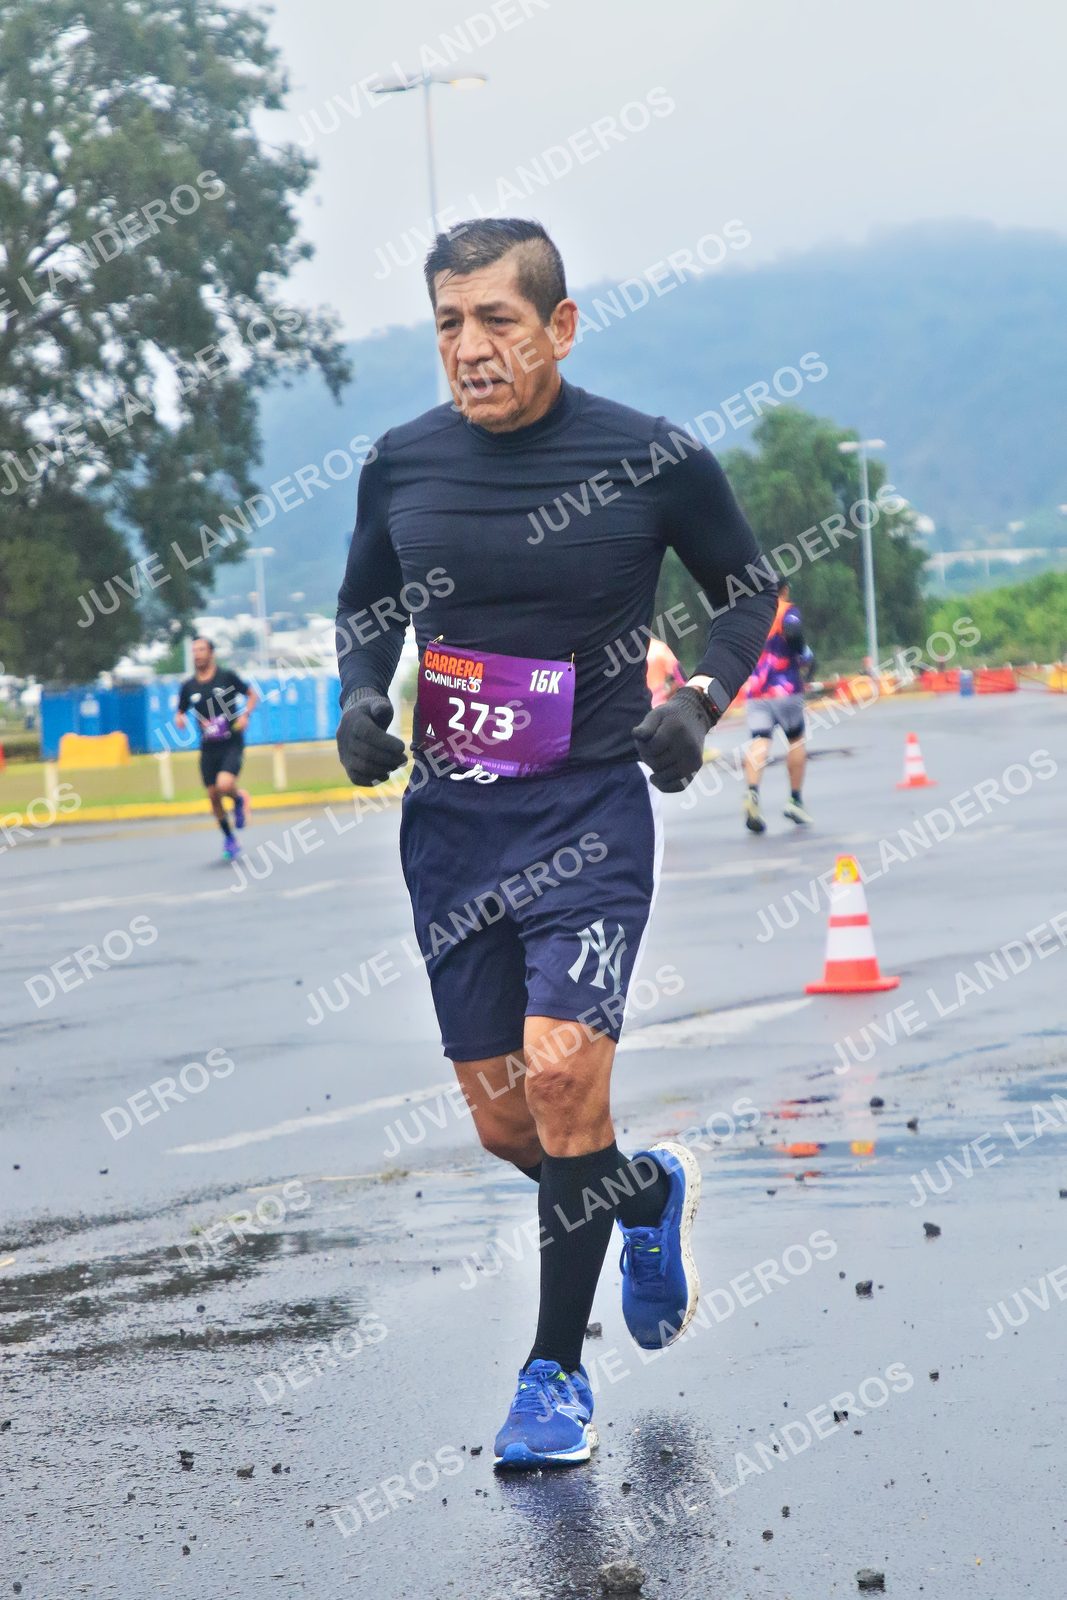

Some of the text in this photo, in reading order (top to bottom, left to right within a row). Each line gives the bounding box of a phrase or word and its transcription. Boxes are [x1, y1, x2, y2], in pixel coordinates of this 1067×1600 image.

[424, 650, 484, 680] CARRERA
[530, 669, 563, 694] 15K
[448, 697, 515, 741] 273
[567, 918, 627, 997] NY
